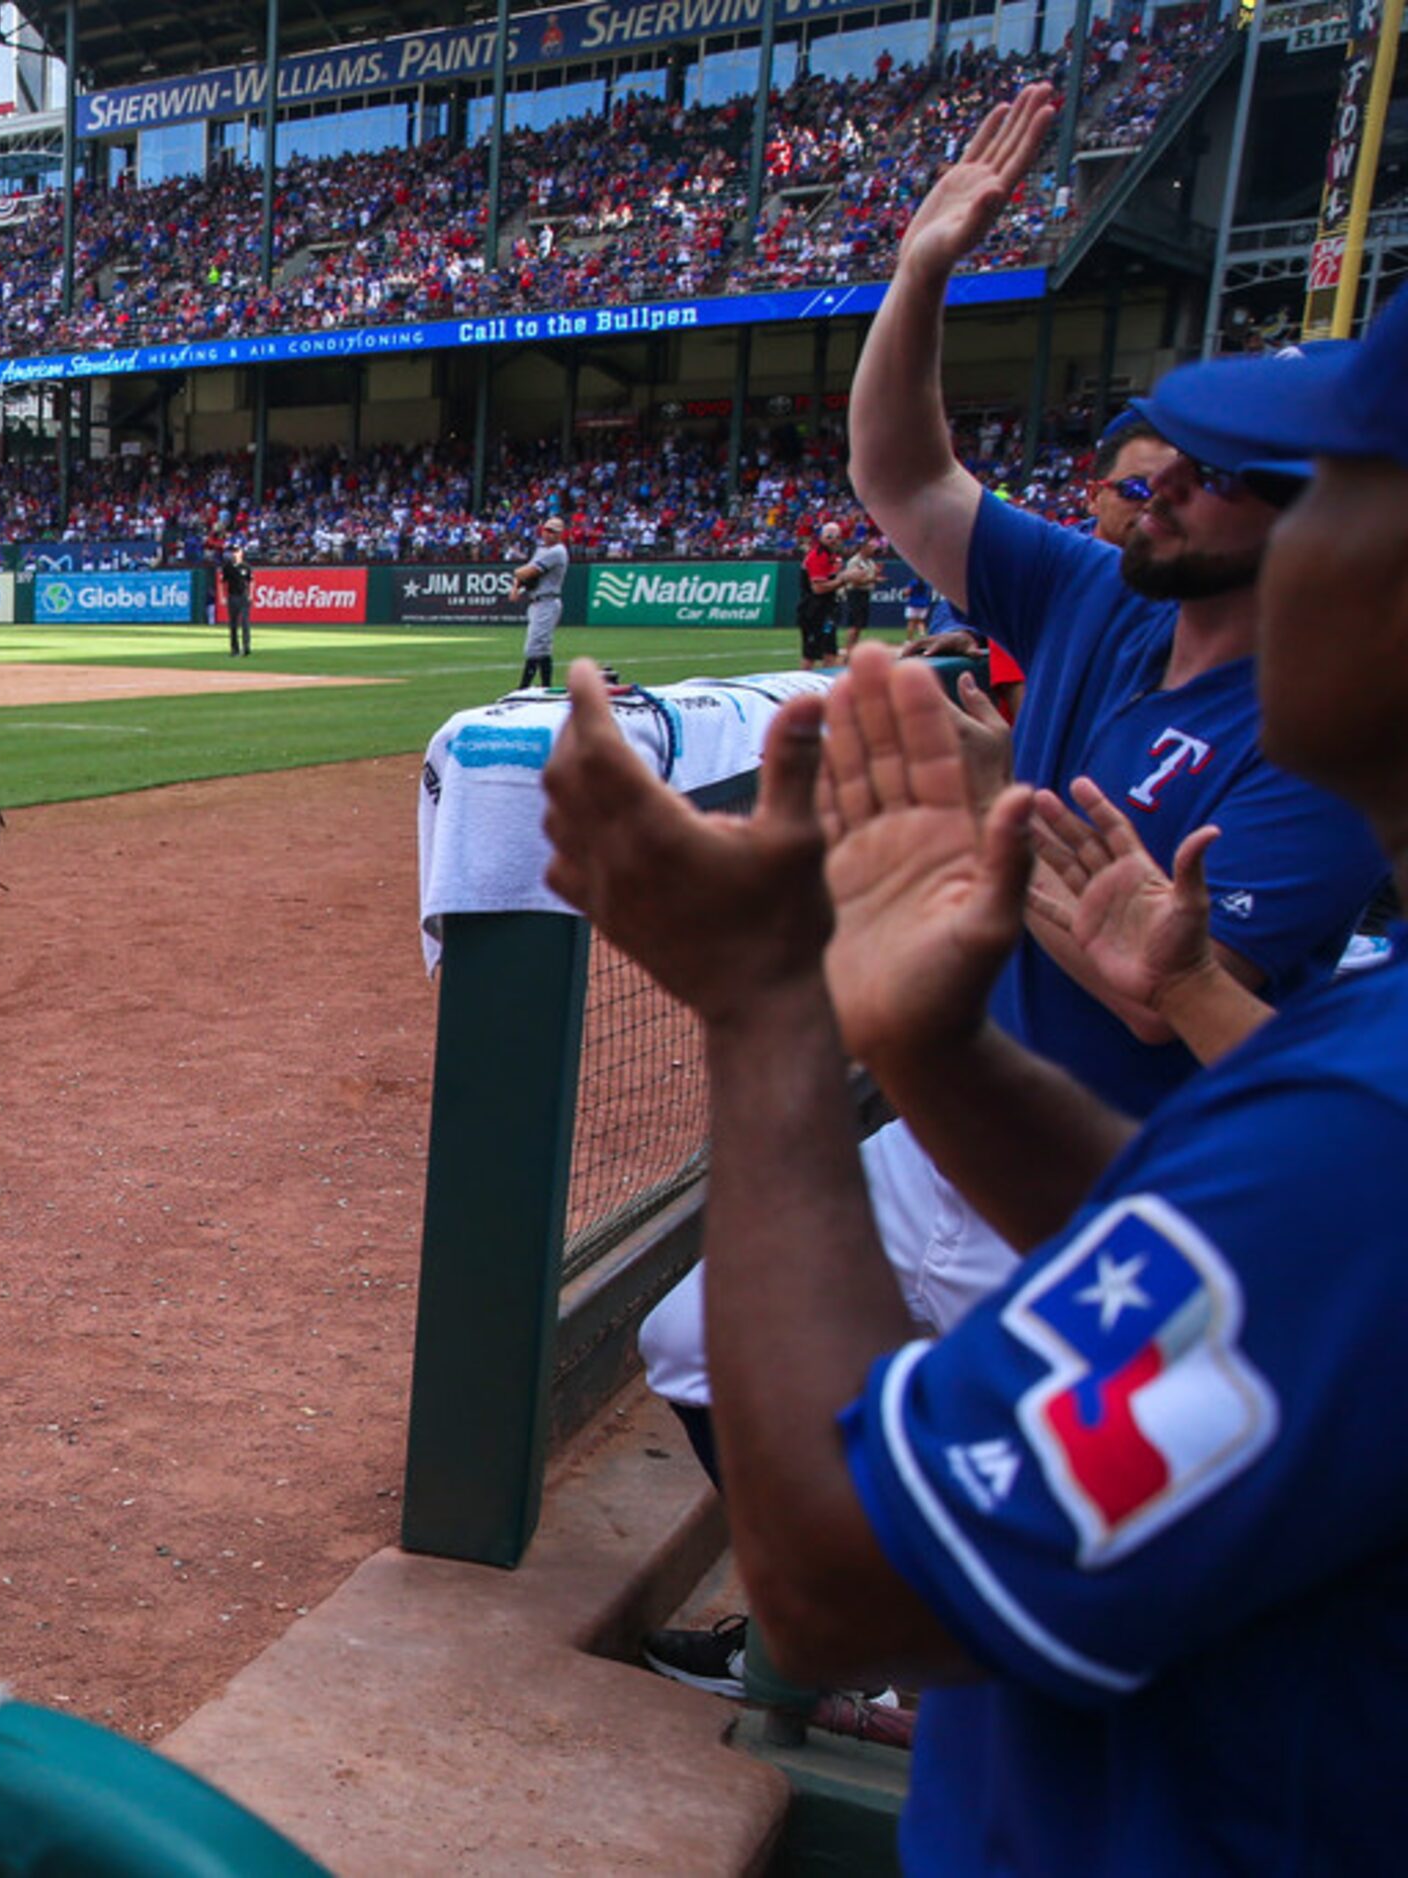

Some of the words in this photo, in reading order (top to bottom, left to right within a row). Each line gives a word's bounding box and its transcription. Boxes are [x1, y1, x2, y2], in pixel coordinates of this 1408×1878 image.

[86, 53, 385, 131] SHERWIN-WLLIAMS
[250, 343, 277, 356] AIR
[459, 320, 506, 342] Call
[515, 318, 538, 338] to
[547, 313, 587, 335] the
[596, 306, 698, 331] Bullpen
[78, 581, 147, 608] Globe
[150, 584, 190, 607] Life
[422, 574, 460, 594] JIM
[467, 572, 526, 595] ROS
[631, 574, 771, 604] National
[676, 607, 704, 620] Car
[707, 606, 761, 620] Rental
[1127, 727, 1215, 813] T
